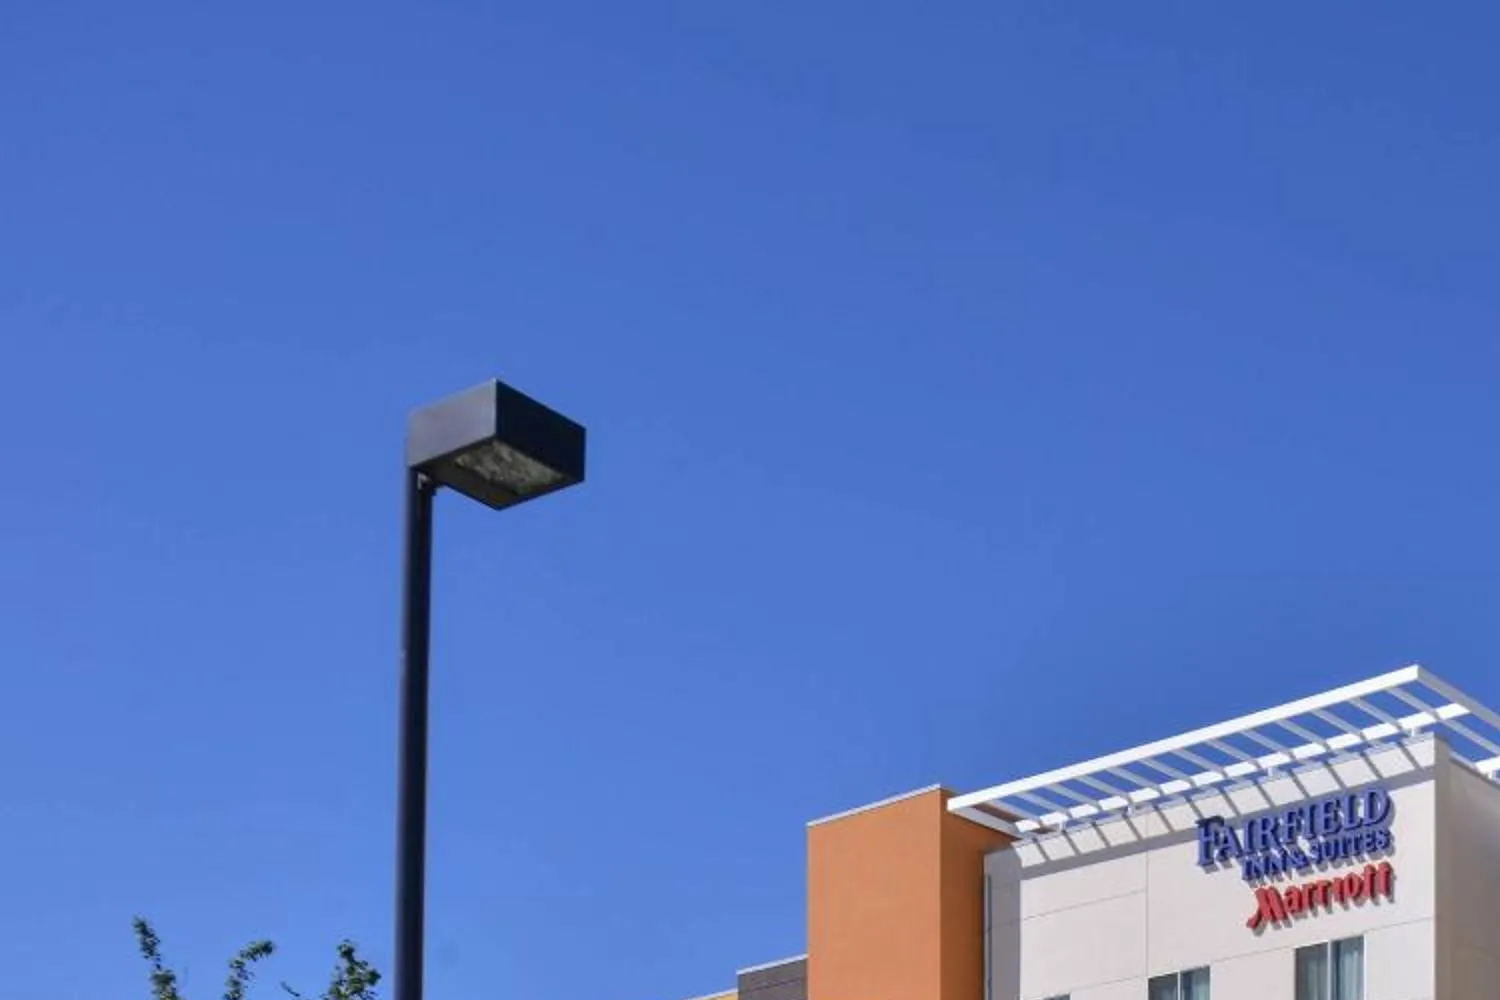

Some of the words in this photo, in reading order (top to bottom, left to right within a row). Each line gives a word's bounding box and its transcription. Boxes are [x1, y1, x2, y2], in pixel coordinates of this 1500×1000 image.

[1197, 786, 1393, 867] FAIRFIELD
[1243, 850, 1286, 881] INN
[1309, 829, 1391, 863] SUITES
[1246, 861, 1394, 929] Marriott
